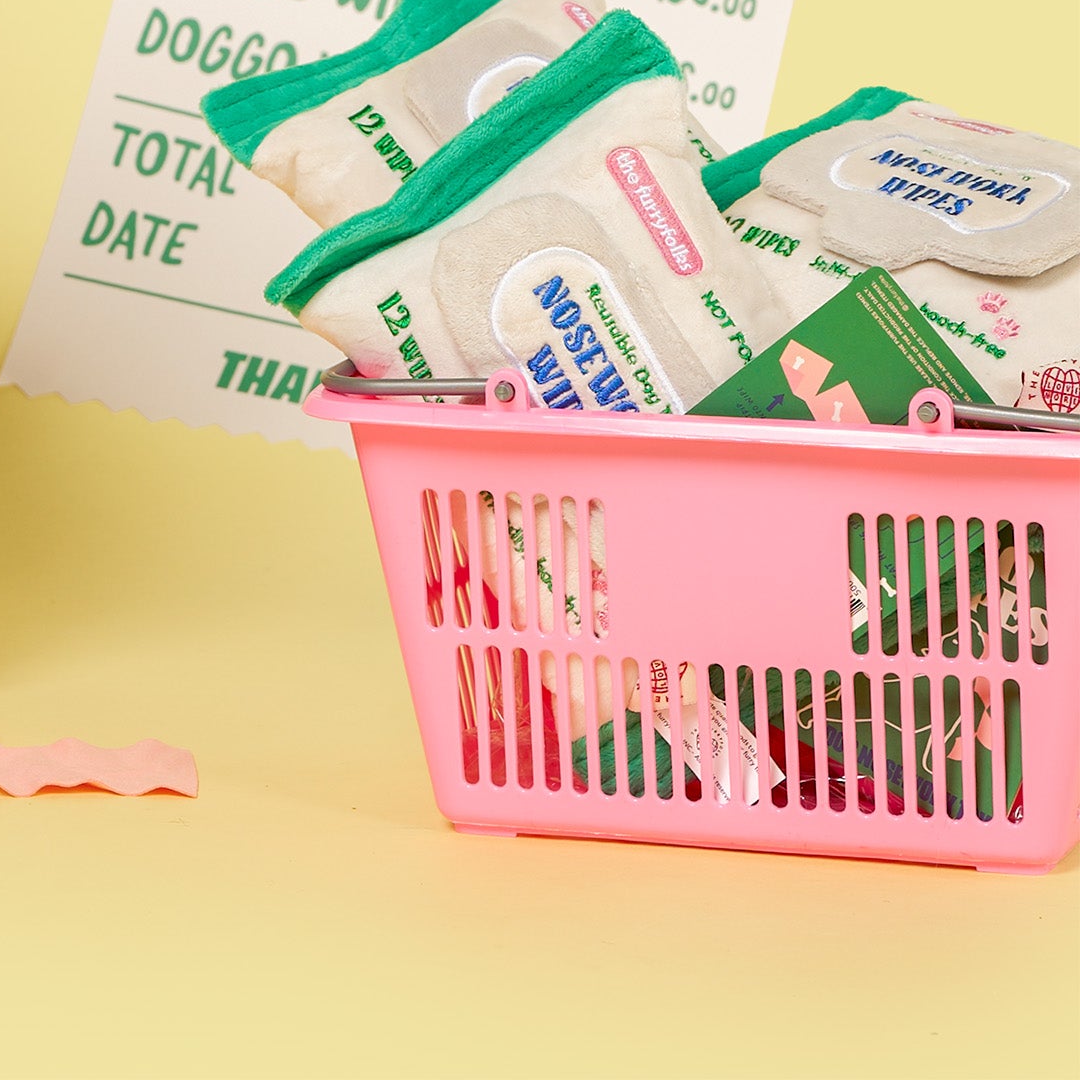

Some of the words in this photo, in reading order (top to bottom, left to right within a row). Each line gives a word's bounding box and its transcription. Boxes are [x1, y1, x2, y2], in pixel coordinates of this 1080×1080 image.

[348, 104, 386, 138] 12
[114, 124, 235, 196] TOTAL
[82, 202, 196, 264] DATE
[615, 151, 641, 187] the
[635, 178, 694, 273] furryfolks
[741, 226, 800, 256] WIPES
[378, 292, 411, 335] 12
[702, 291, 734, 328] NOT
[587, 283, 636, 364] Reusable
[633, 367, 660, 406] Dog
[218, 351, 321, 402] THA
[1027, 370, 1040, 400] THE
[1046, 381, 1079, 395] LOVE
